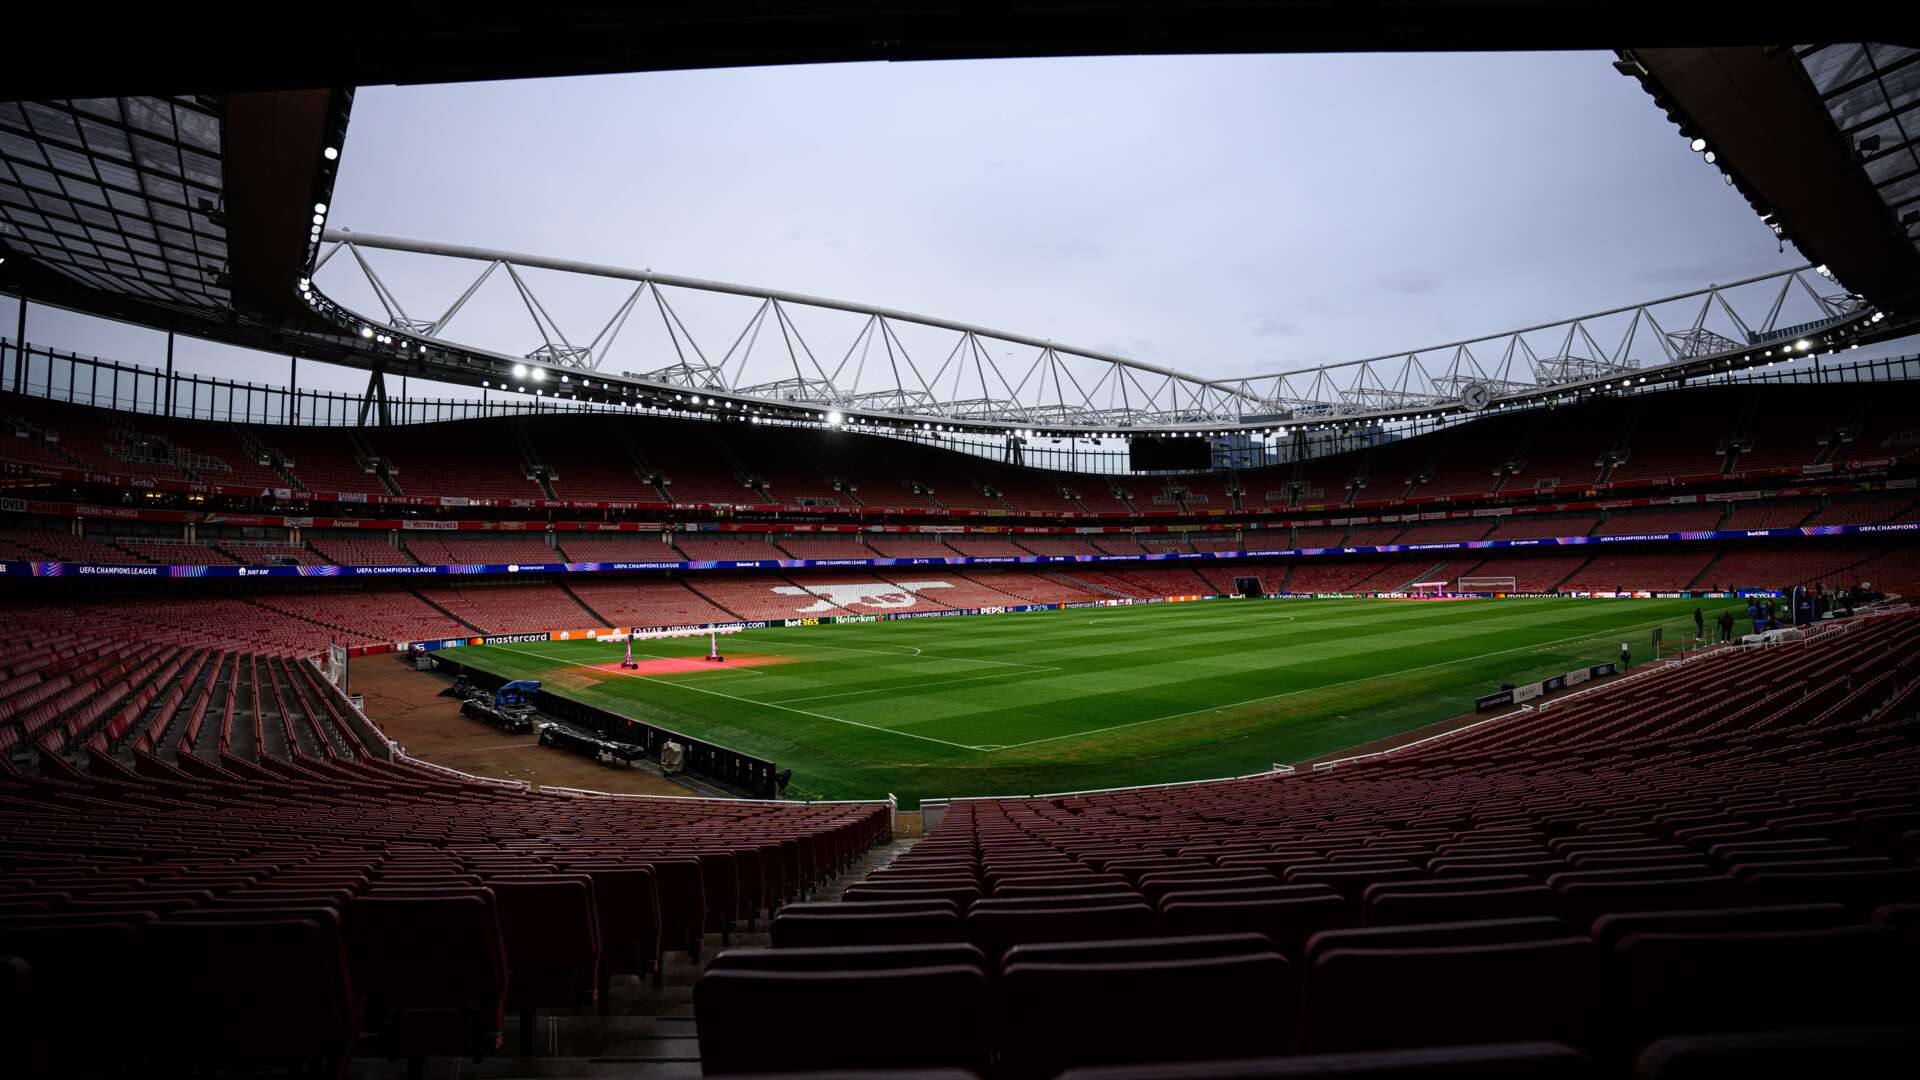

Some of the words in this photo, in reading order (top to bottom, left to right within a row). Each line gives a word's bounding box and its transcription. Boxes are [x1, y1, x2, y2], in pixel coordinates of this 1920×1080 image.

[79, 566, 95, 574] UEFA
[97, 567, 130, 575] CHAMPIONS
[980, 607, 1005, 615] PEPSI
[785, 617, 819, 627] bet365
[836, 615, 876, 624] Heineken
[634, 626, 662, 634] QATAR
[485, 633, 547, 645] mastercard
